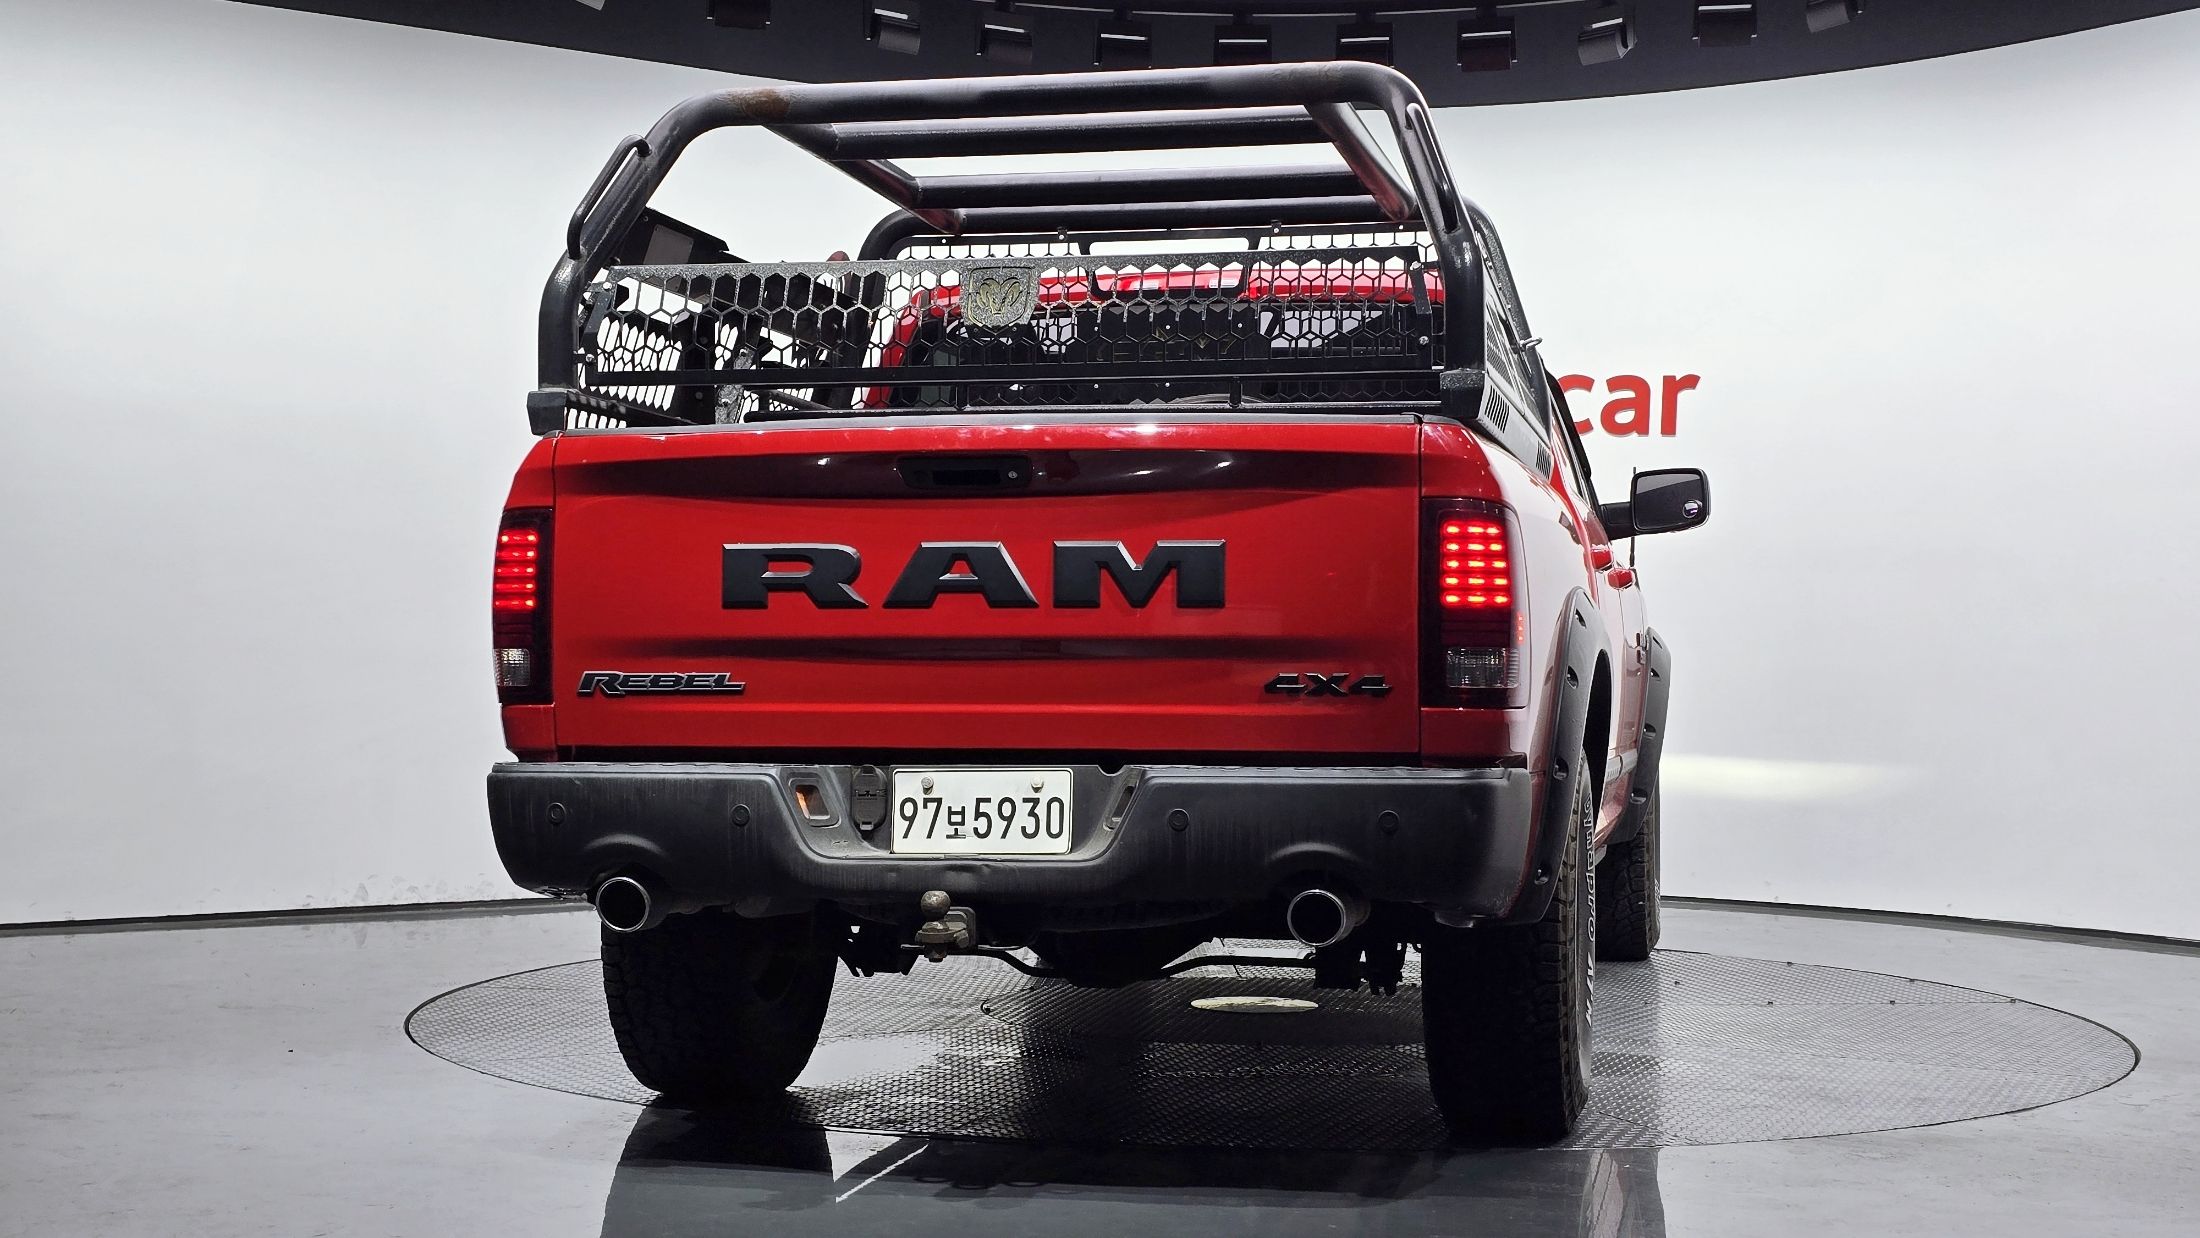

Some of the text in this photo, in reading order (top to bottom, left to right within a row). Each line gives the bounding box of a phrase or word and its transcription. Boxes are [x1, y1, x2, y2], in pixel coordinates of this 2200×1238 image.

[721, 540, 1226, 608] RAM
[578, 670, 746, 695] REBEL
[1264, 672, 1392, 697] 4X4
